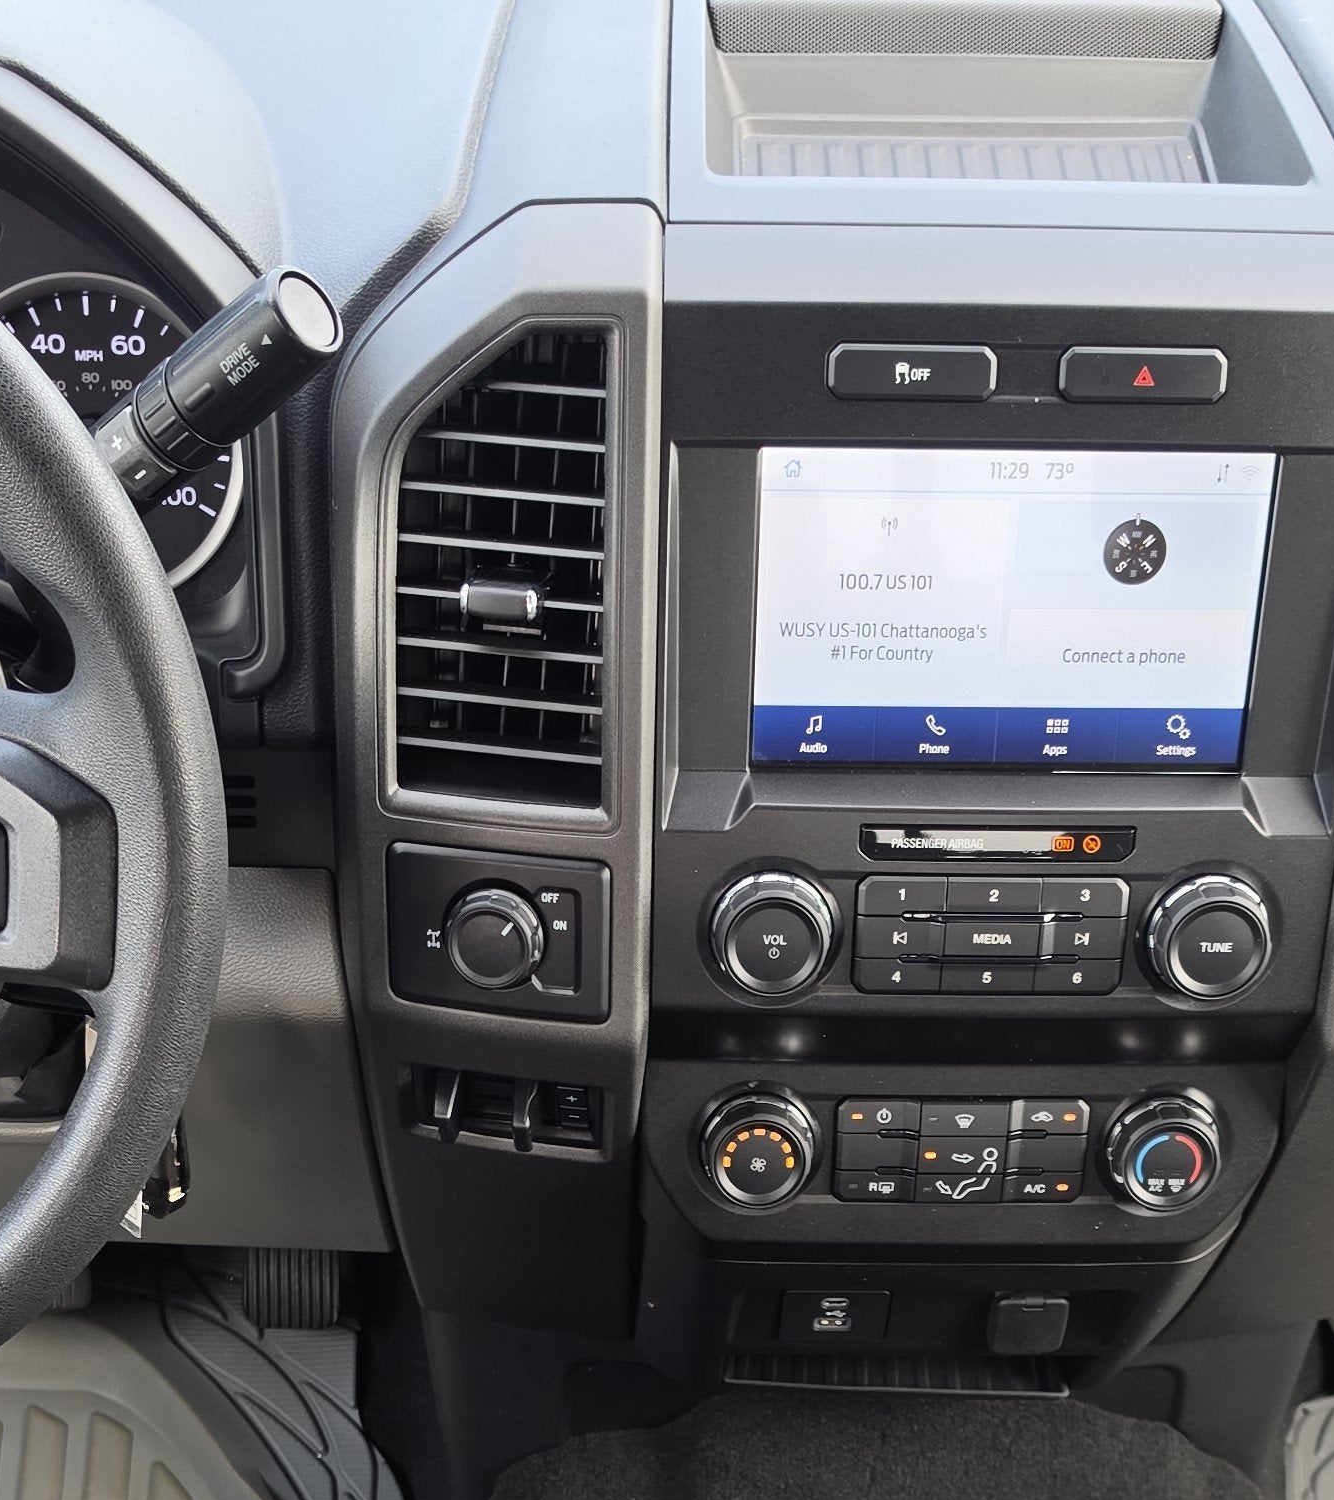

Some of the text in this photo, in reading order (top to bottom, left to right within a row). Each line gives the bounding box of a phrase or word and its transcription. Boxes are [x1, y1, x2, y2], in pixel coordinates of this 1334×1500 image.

[31, 333, 65, 354] 40
[111, 335, 146, 355] 60
[74, 350, 104, 362] MPH
[219, 342, 252, 374] DRIVE
[227, 355, 261, 387] MODE
[911, 368, 931, 381] OFF
[81, 372, 100, 384] 80
[111, 379, 133, 391] 100
[990, 462, 1029, 479] 11:29
[161, 486, 197, 506] 00
[839, 573, 933, 590] 100.7 US 101
[779, 622, 987, 641] WUSY US-101 Chattanooga's
[831, 646, 933, 663] #1 For Country
[1062, 648, 1186, 666] Connect a phone
[799, 742, 828, 754] Audio
[918, 743, 950, 755] Phone
[1042, 744, 1068, 756] Apps
[1156, 744, 1197, 757] Settings
[891, 838, 1071, 850] PASSENGER AIRBAG ON
[541, 893, 560, 904] OFF
[898, 890, 907, 902] 1
[989, 890, 999, 902] 2
[1080, 890, 1091, 902] 3
[553, 919, 568, 931] ON
[763, 934, 787, 946] VOL
[973, 933, 1012, 946] MEDIA
[1200, 941, 1234, 955] TUNE
[892, 971, 902, 984] 4
[982, 972, 992, 984] 5
[1072, 972, 1082, 985] 6
[1024, 1184, 1046, 1194] A/C
